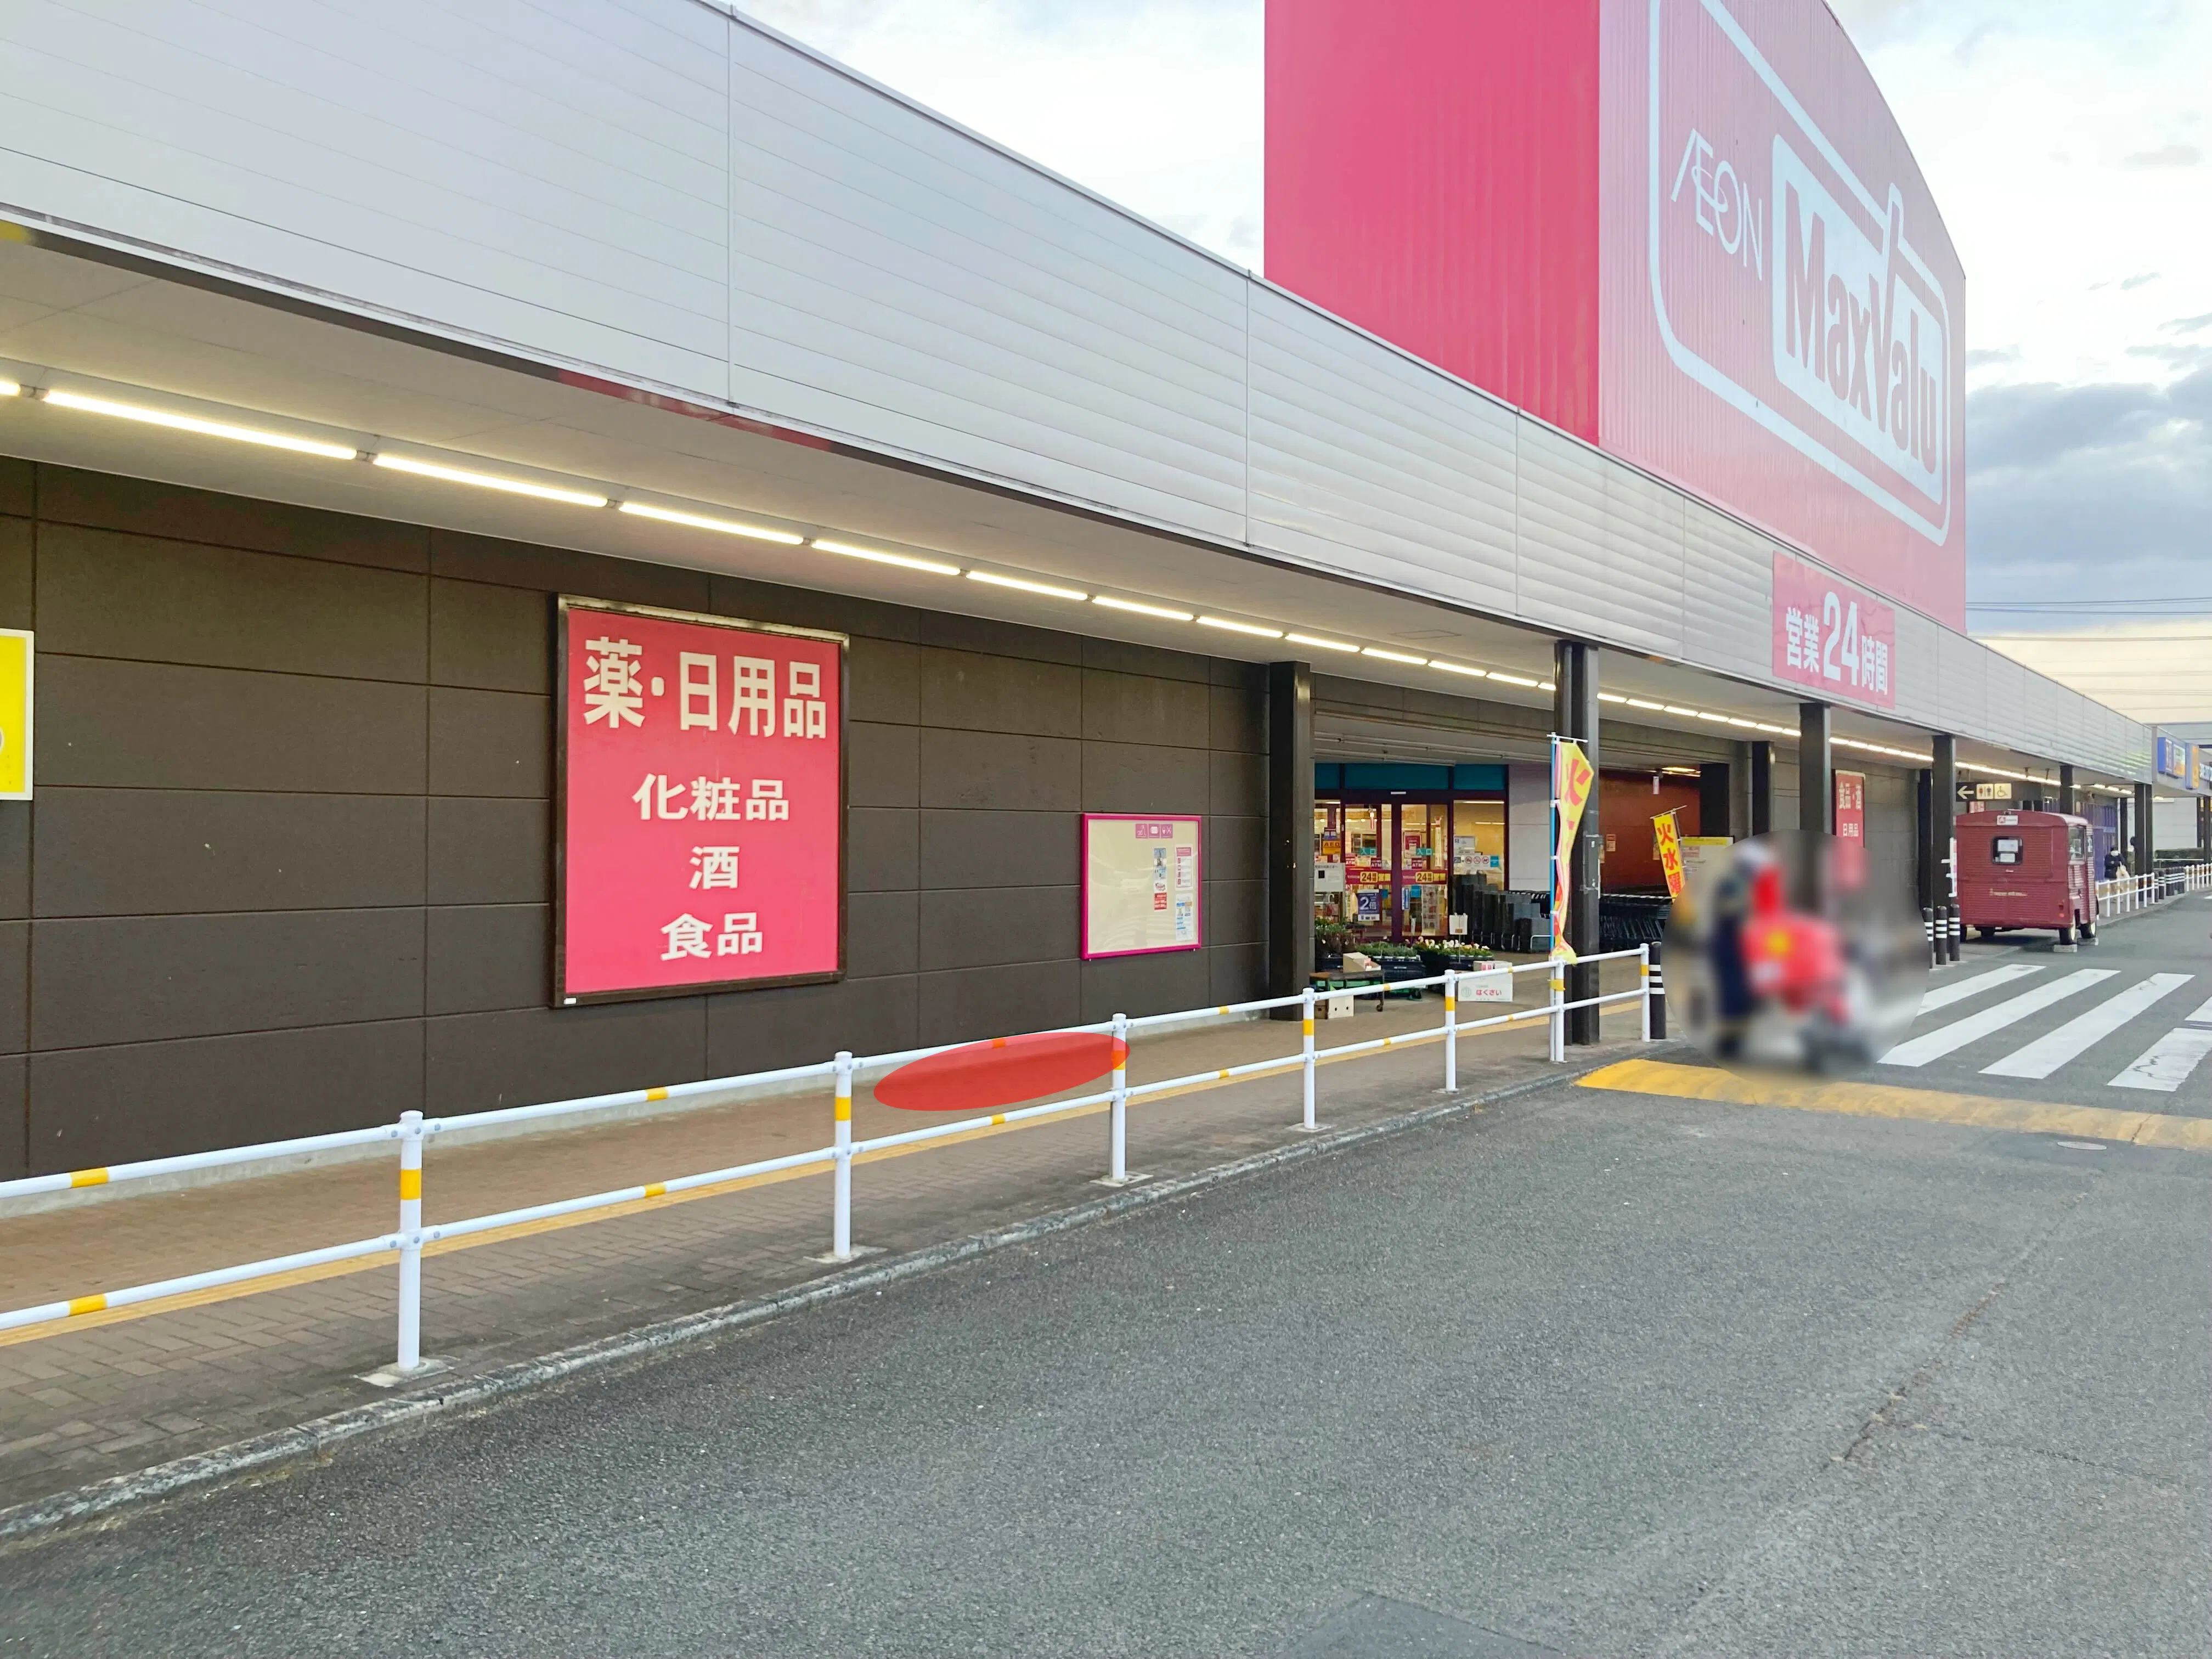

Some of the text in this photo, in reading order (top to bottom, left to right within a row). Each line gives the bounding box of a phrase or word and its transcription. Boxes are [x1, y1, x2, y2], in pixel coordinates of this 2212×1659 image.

[1786, 179, 1937, 475] MaxValu
[1786, 591, 1888, 696] 営業24時間
[632, 773, 789, 821] 化粧品
[689, 845, 740, 890] 酒
[661, 912, 763, 961] 食品
